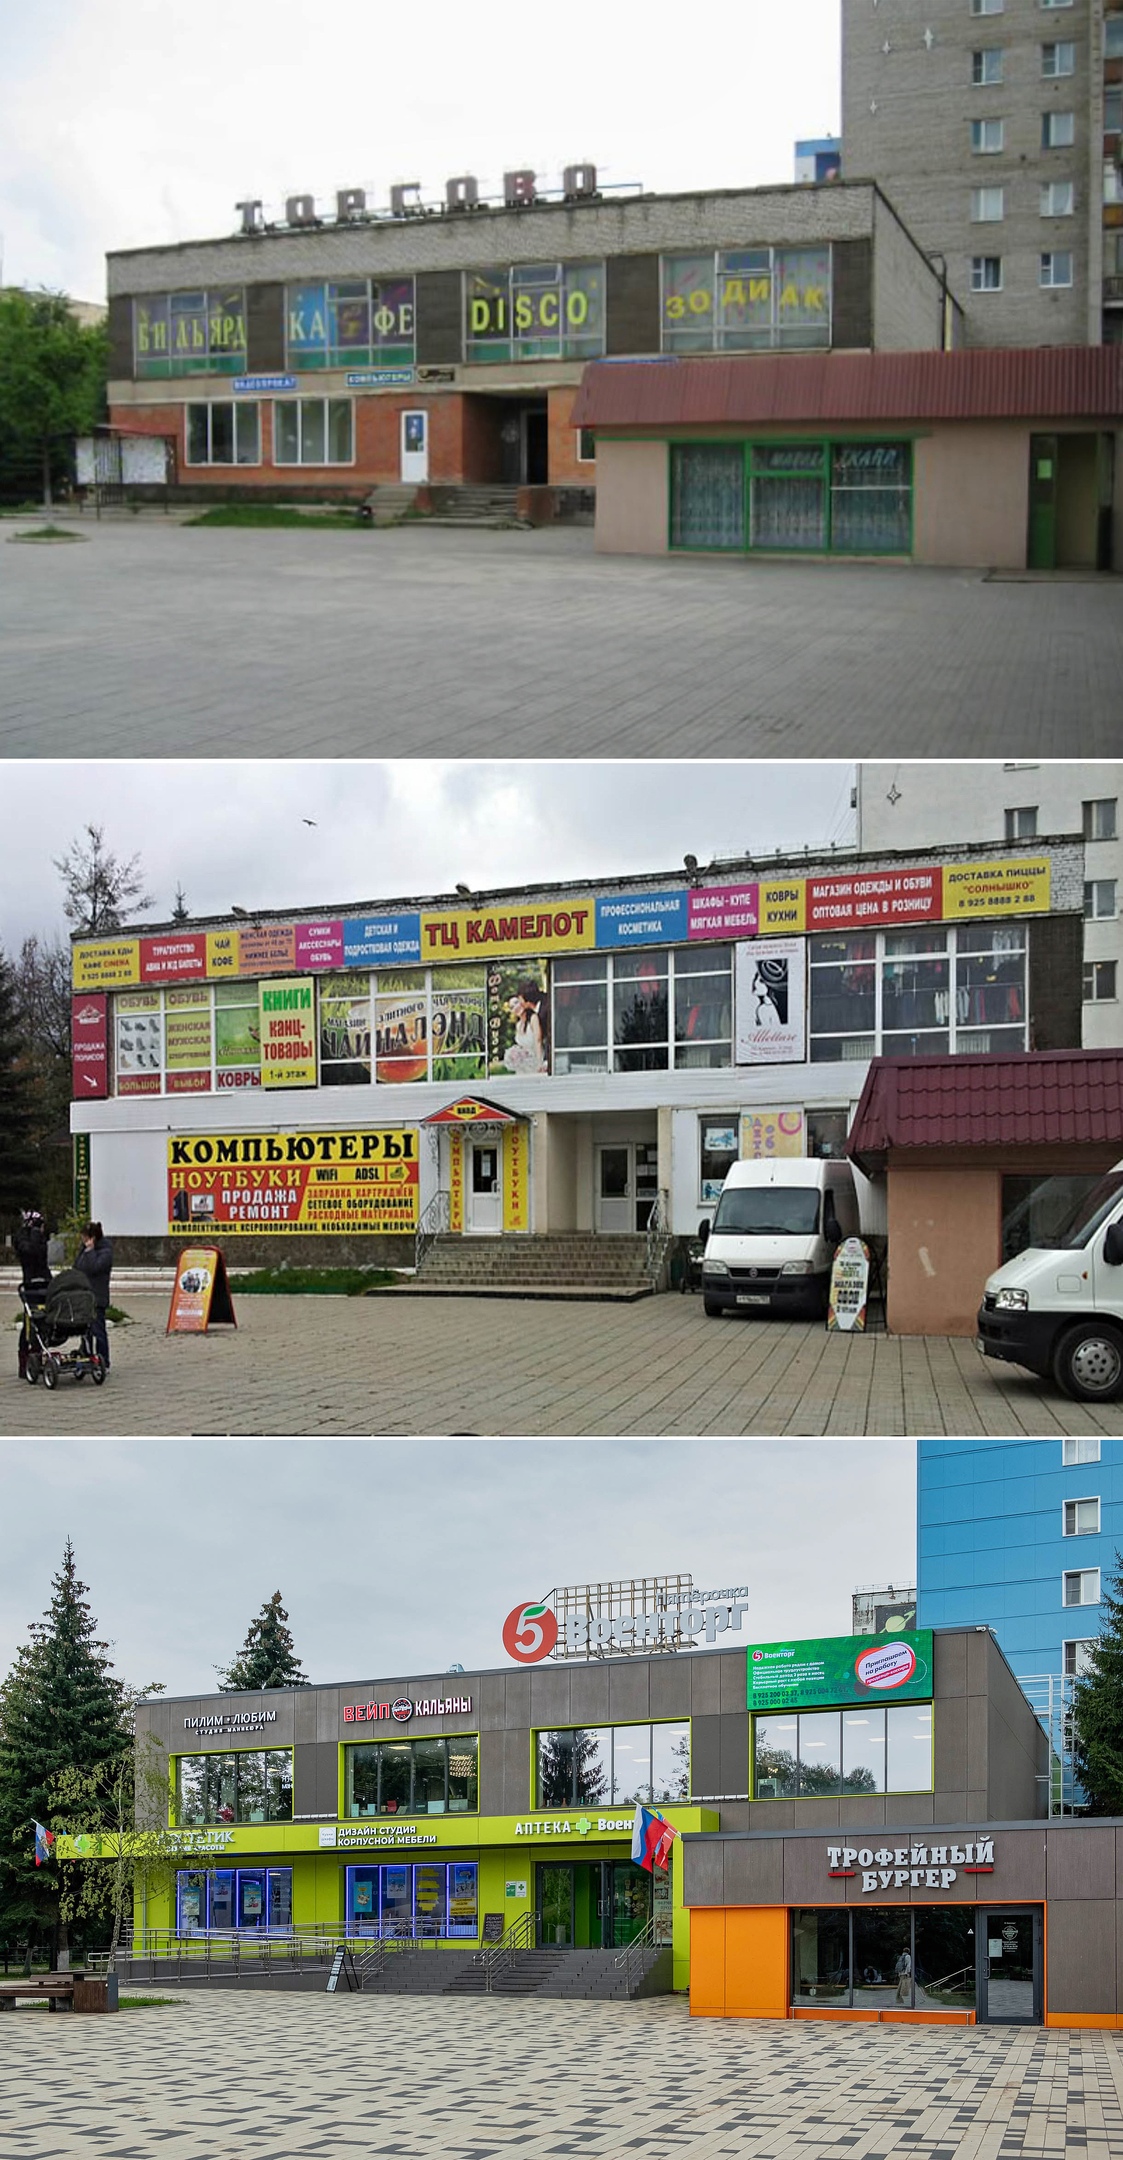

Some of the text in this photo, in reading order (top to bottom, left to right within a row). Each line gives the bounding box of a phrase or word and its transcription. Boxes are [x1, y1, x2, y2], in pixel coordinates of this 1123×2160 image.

[666, 277, 823, 320] ЗОДИАК
[471, 290, 588, 332] DISCO
[138, 312, 246, 352] БИЛЬЯРД
[949, 866, 1046, 883] ДОСТАВКА ПИЦЦЫ
[813, 875, 932, 898] МАГАЗИН ОДЕЖДЫ И ОБУВИ
[963, 880, 1034, 894] "СОЛНЫШКО"
[766, 889, 798, 903] КОВРЫ
[968, 898, 985, 906] 925
[988, 896, 1011, 905] 8888
[1014, 895, 1020, 903] 2
[1023, 894, 1035, 902] 88
[601, 899, 680, 917] ПРОФЕССИОНАЛЬНАЯ
[813, 896, 932, 919] ОПТОВАЯ ЦЕНА В РОЗНИЦУ
[690, 912, 757, 929] МЯГКАЯ МЕБЕЛЬ
[767, 910, 797, 923] КУХНИ
[241, 928, 293, 940] ЖЕНСКАЯ ОДЕЖДА
[308, 926, 331, 937] СУМКИ
[365, 924, 398, 939] ДЕТСКАЯ И
[425, 911, 588, 949] ТЦ КАМЕЛОТ
[618, 920, 662, 935] КОСМЕТИКА
[153, 943, 195, 956] ТУРАГЕНТСТВО
[215, 937, 230, 949] ЧАЙ
[344, 940, 420, 957] ПОДРОСТКОВАЯ ОДЕЖДА
[80, 947, 133, 959] ДОСТАВКА ЕДЫ
[245, 951, 268, 959] НИЖНЕЕ
[310, 952, 332, 962] ОБУВЬ
[84, 961, 101, 969] КАФЕ
[146, 961, 160, 971] АВИА
[178, 958, 203, 969] БИЛЕТЫ
[212, 956, 233, 967] КОФЕ
[120, 998, 158, 1008] ОБУВЬ
[169, 992, 207, 1004] ОБУВЬ
[379, 1001, 424, 1023] ЭЛИТНОГО
[327, 1016, 366, 1029] МАГАЗИН
[74, 1041, 105, 1051] ПРОДАЖА
[168, 1036, 211, 1046] МУЖСКАЯ
[74, 1053, 104, 1062] ПОЛИСОВ
[174, 1077, 205, 1088] ВЫБОР
[217, 1070, 261, 1088] КОВРЫ
[171, 1133, 414, 1164] КОМПЬЮТЕРЫ
[316, 1167, 379, 1181] WIFI ADSL
[511, 1125, 519, 1209] НОУТБУКИ
[171, 1169, 301, 1189] НОУТБУКИ
[452, 1128, 462, 1230] КОМПЬЮТЕРЫ
[222, 1189, 297, 1206] ПРОДАЖА
[307, 1188, 351, 1199] ЗАПРАВКА
[307, 1197, 413, 1209] СЕТЕВОЕ ОБОРУДОВАНИЕ
[229, 1205, 290, 1220] РЕМОНТ
[307, 1207, 413, 1220] РАСХОДНЫЕ МАТЕРИАЛЫ
[321, 1221, 380, 1232] НЕОБХОДИМЫЕ
[382, 1220, 415, 1231] МЕЛОЧИ
[656, 1586, 748, 1607] Пятёрочка
[565, 1602, 748, 1647] Военторг
[764, 1651, 795, 1659] Военторг
[866, 1650, 907, 1668] Приглашаем
[874, 1661, 898, 1673] работу
[343, 1701, 389, 1722] ВЕЙП
[415, 1696, 471, 1716] КАЛЬЯНЫ
[184, 1711, 276, 1728] ПИЛИМ ЛЮБИМ
[338, 1826, 416, 1837] ДИЗАЙН СТУДИЯ
[515, 1821, 571, 1835] АПТЕКА
[338, 1835, 436, 1846] КОРПУСНОЙ МЕБЕЛИ
[827, 1835, 994, 1867] ТРОФЕЙНЫЙ
[862, 1868, 957, 1892] БУРГЕР
